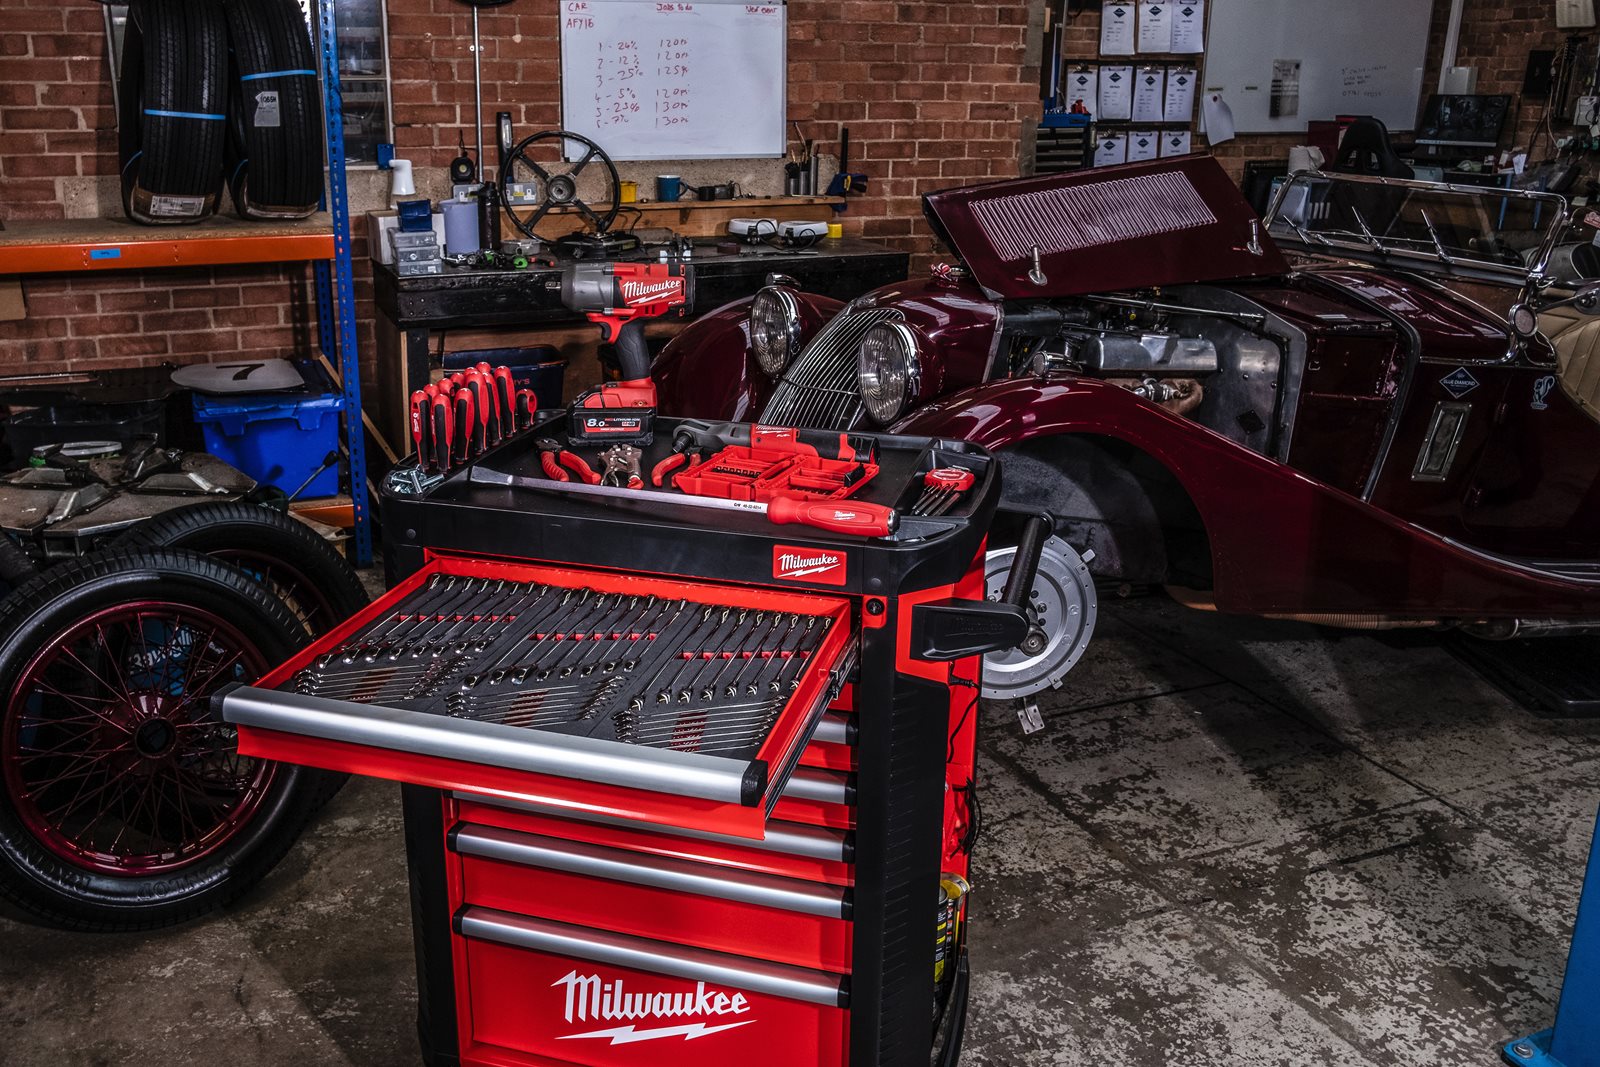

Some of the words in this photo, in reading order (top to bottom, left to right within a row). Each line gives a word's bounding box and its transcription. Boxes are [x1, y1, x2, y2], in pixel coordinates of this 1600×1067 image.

[568, 2, 588, 12] CAR
[622, 280, 680, 298] Milwaukee
[216, 364, 264, 380] 7
[587, 418, 606, 426] 8.0
[778, 553, 838, 571] Milwaukee
[550, 970, 750, 1024] Milwaukee
